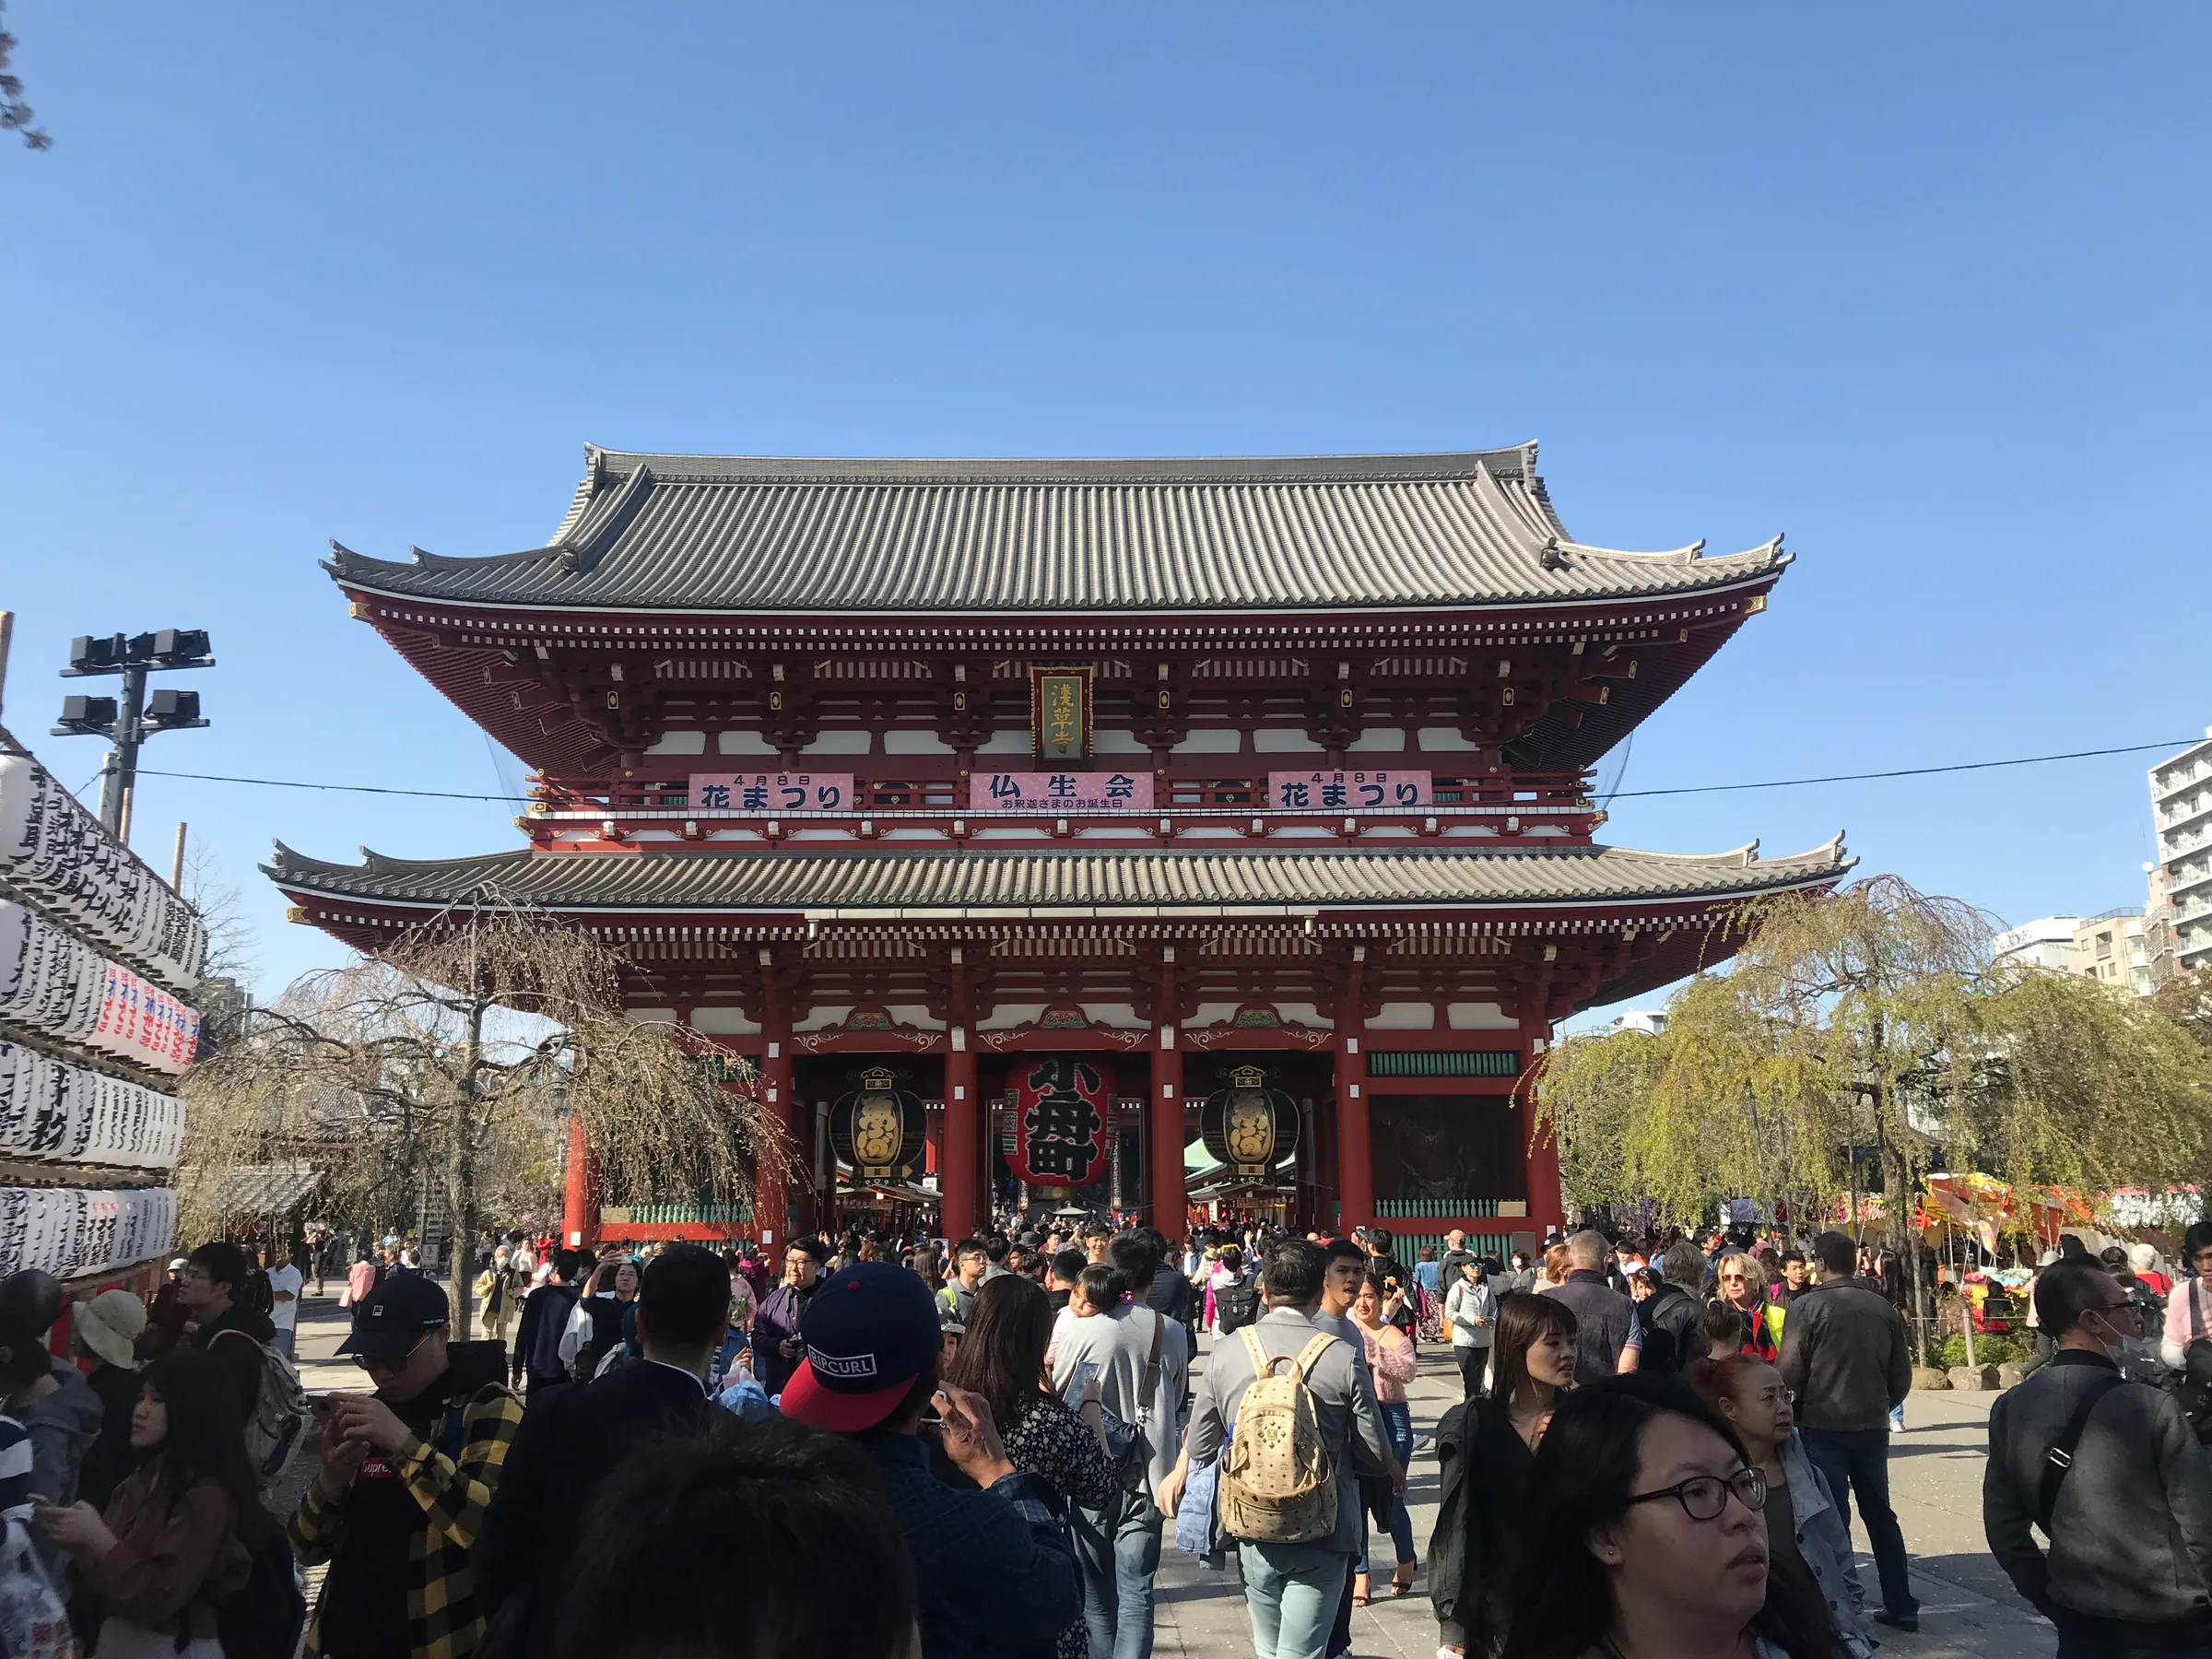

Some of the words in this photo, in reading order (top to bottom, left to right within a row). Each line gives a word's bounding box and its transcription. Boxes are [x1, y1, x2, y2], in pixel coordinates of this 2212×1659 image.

[700, 785, 841, 809] 花まつり
[988, 773, 1135, 799] 仏生会
[1280, 782, 1418, 806] 花まつり
[1024, 1060, 1102, 1182] 小舟町
[362, 1460, 392, 1477] Supre
